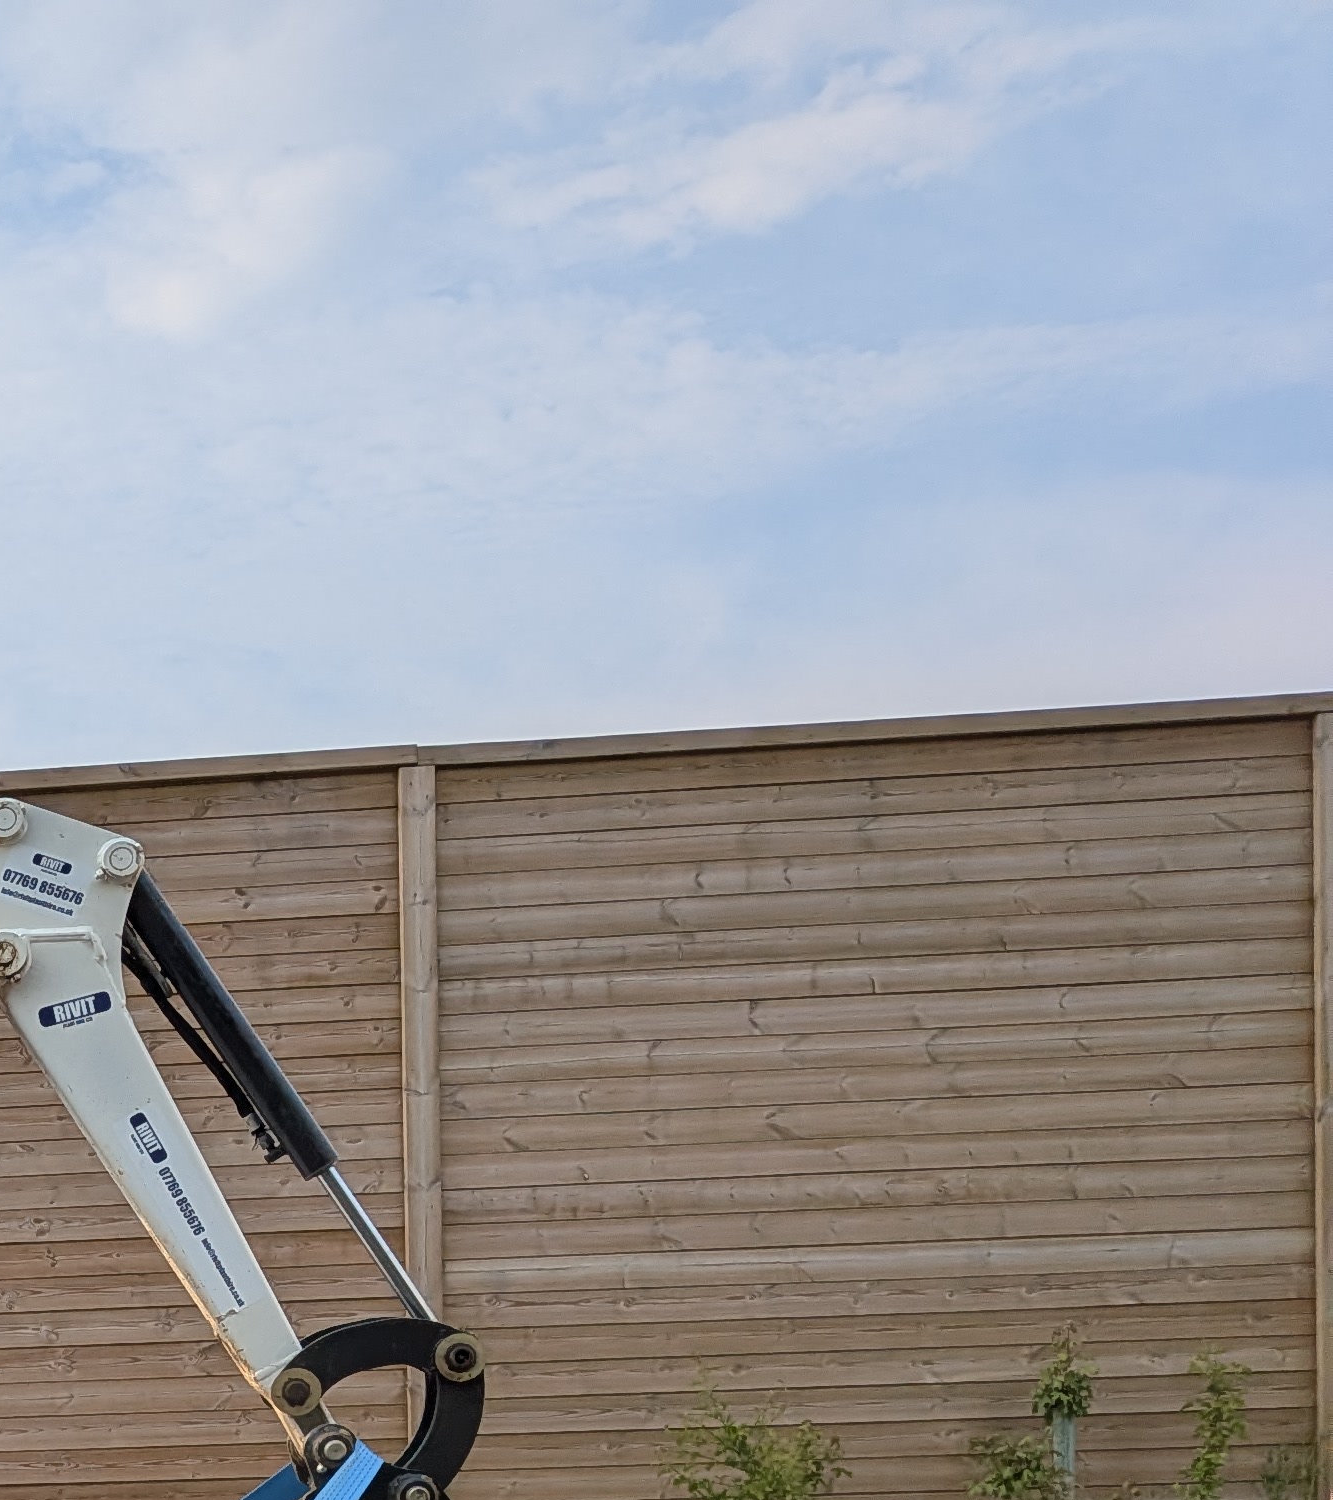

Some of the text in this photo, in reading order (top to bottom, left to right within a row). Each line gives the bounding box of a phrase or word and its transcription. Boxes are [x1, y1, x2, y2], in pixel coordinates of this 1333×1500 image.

[2, 868, 84, 905] 07769 855676
[53, 996, 96, 1023] RIVIT
[135, 1121, 162, 1156] RIVIT
[158, 1166, 184, 1199] 07769
[175, 1196, 206, 1236] 855676
